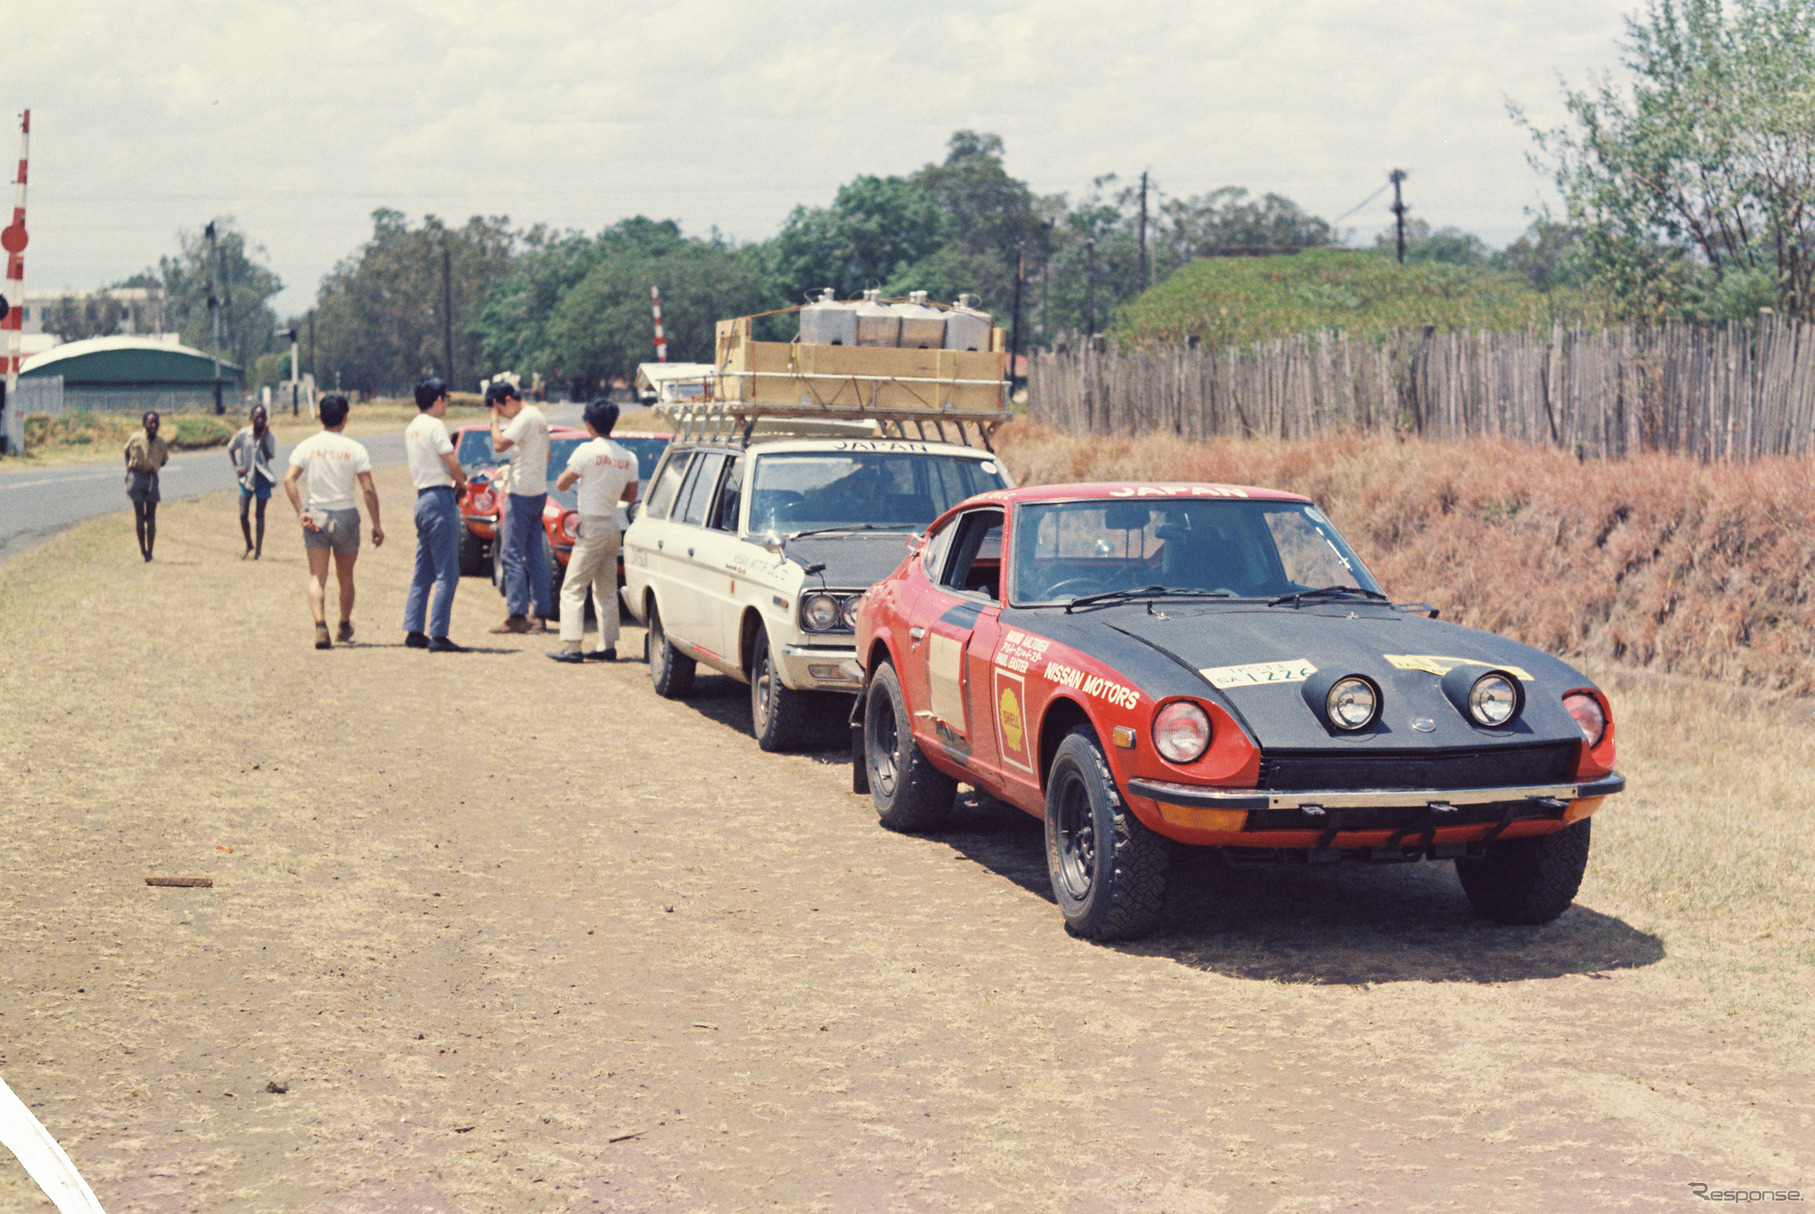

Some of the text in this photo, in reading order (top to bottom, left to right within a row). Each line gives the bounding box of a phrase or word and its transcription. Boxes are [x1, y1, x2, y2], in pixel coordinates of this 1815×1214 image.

[834, 442, 927, 452] JAPAN
[1109, 486, 1249, 498] JAPAN
[1044, 661, 1141, 710] NISSAN MOTORS
[1003, 711, 1020, 729] SHELL
